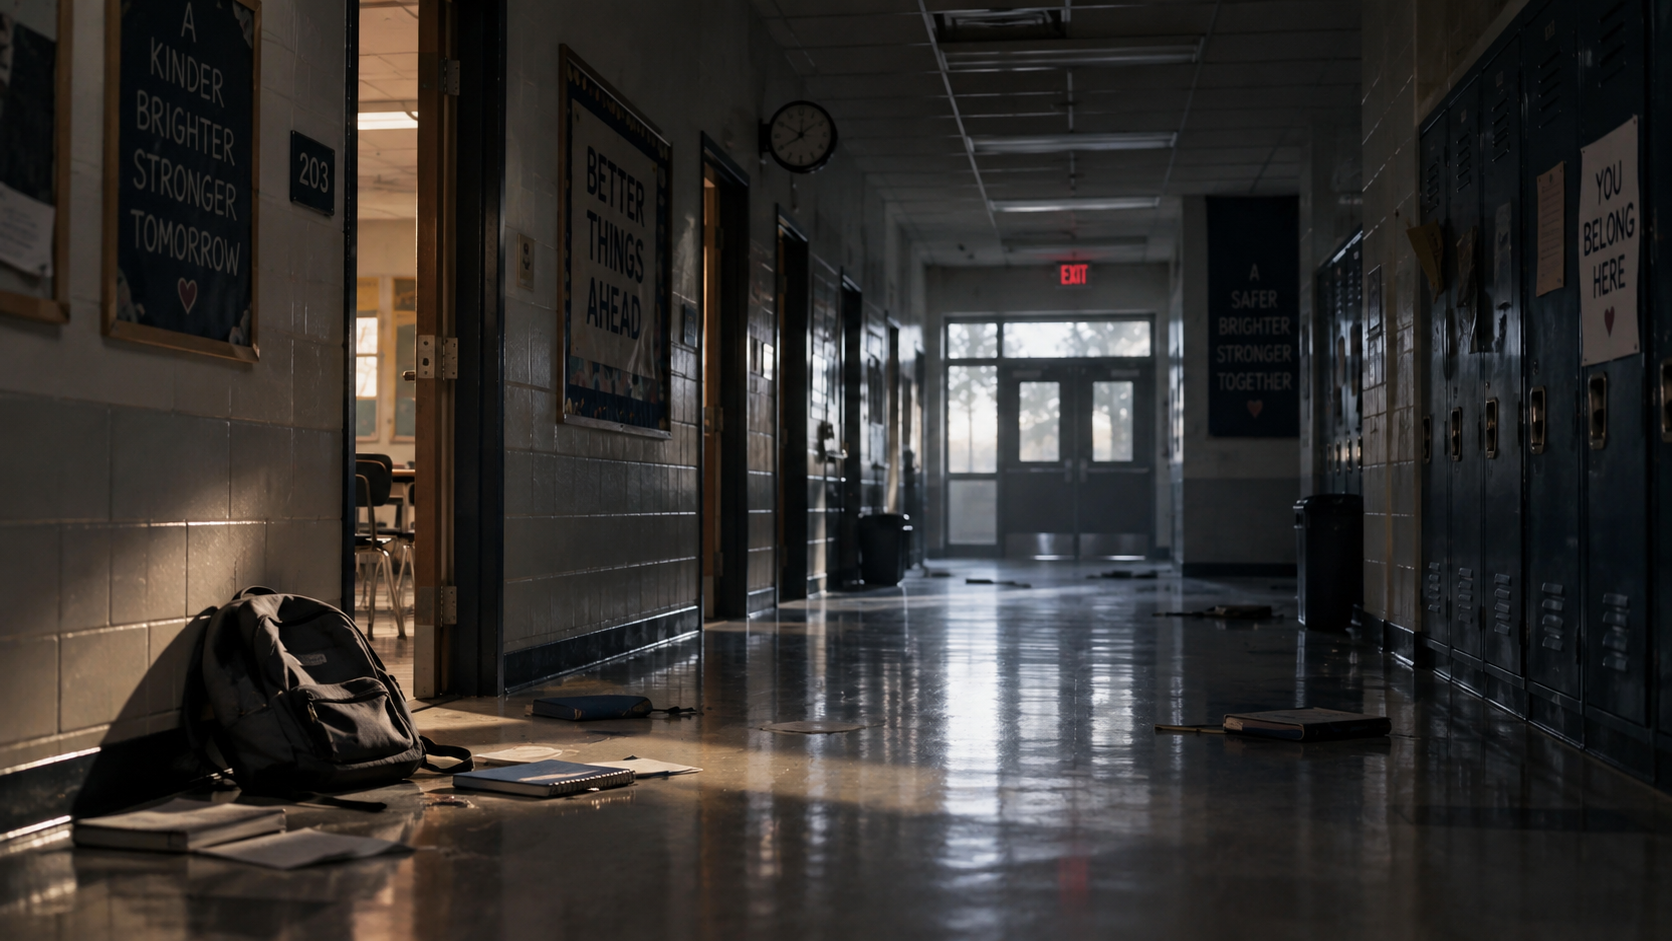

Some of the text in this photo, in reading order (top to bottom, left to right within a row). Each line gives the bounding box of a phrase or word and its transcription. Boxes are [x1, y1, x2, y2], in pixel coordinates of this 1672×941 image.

[181, 2, 197, 43] A
[150, 36, 225, 108] KINDER
[136, 89, 236, 166] BRIGHTER
[133, 148, 238, 221] STRONGER
[299, 152, 329, 194] 203
[587, 146, 645, 227] BETTER
[1596, 161, 1622, 205] YOU
[130, 208, 241, 276] TOMORROW
[587, 210, 644, 284] THINGS
[1583, 202, 1635, 257] BELONG
[1060, 264, 1088, 285] EXIT
[1249, 263, 1260, 281] A
[1593, 254, 1626, 299] HERE
[586, 277, 642, 340] AHEAD
[1231, 290, 1278, 309] SAFER
[1218, 316, 1291, 336] BRIGHTER
[1216, 344, 1292, 363] STRONGER
[1216, 372, 1293, 391] TOGETHER
